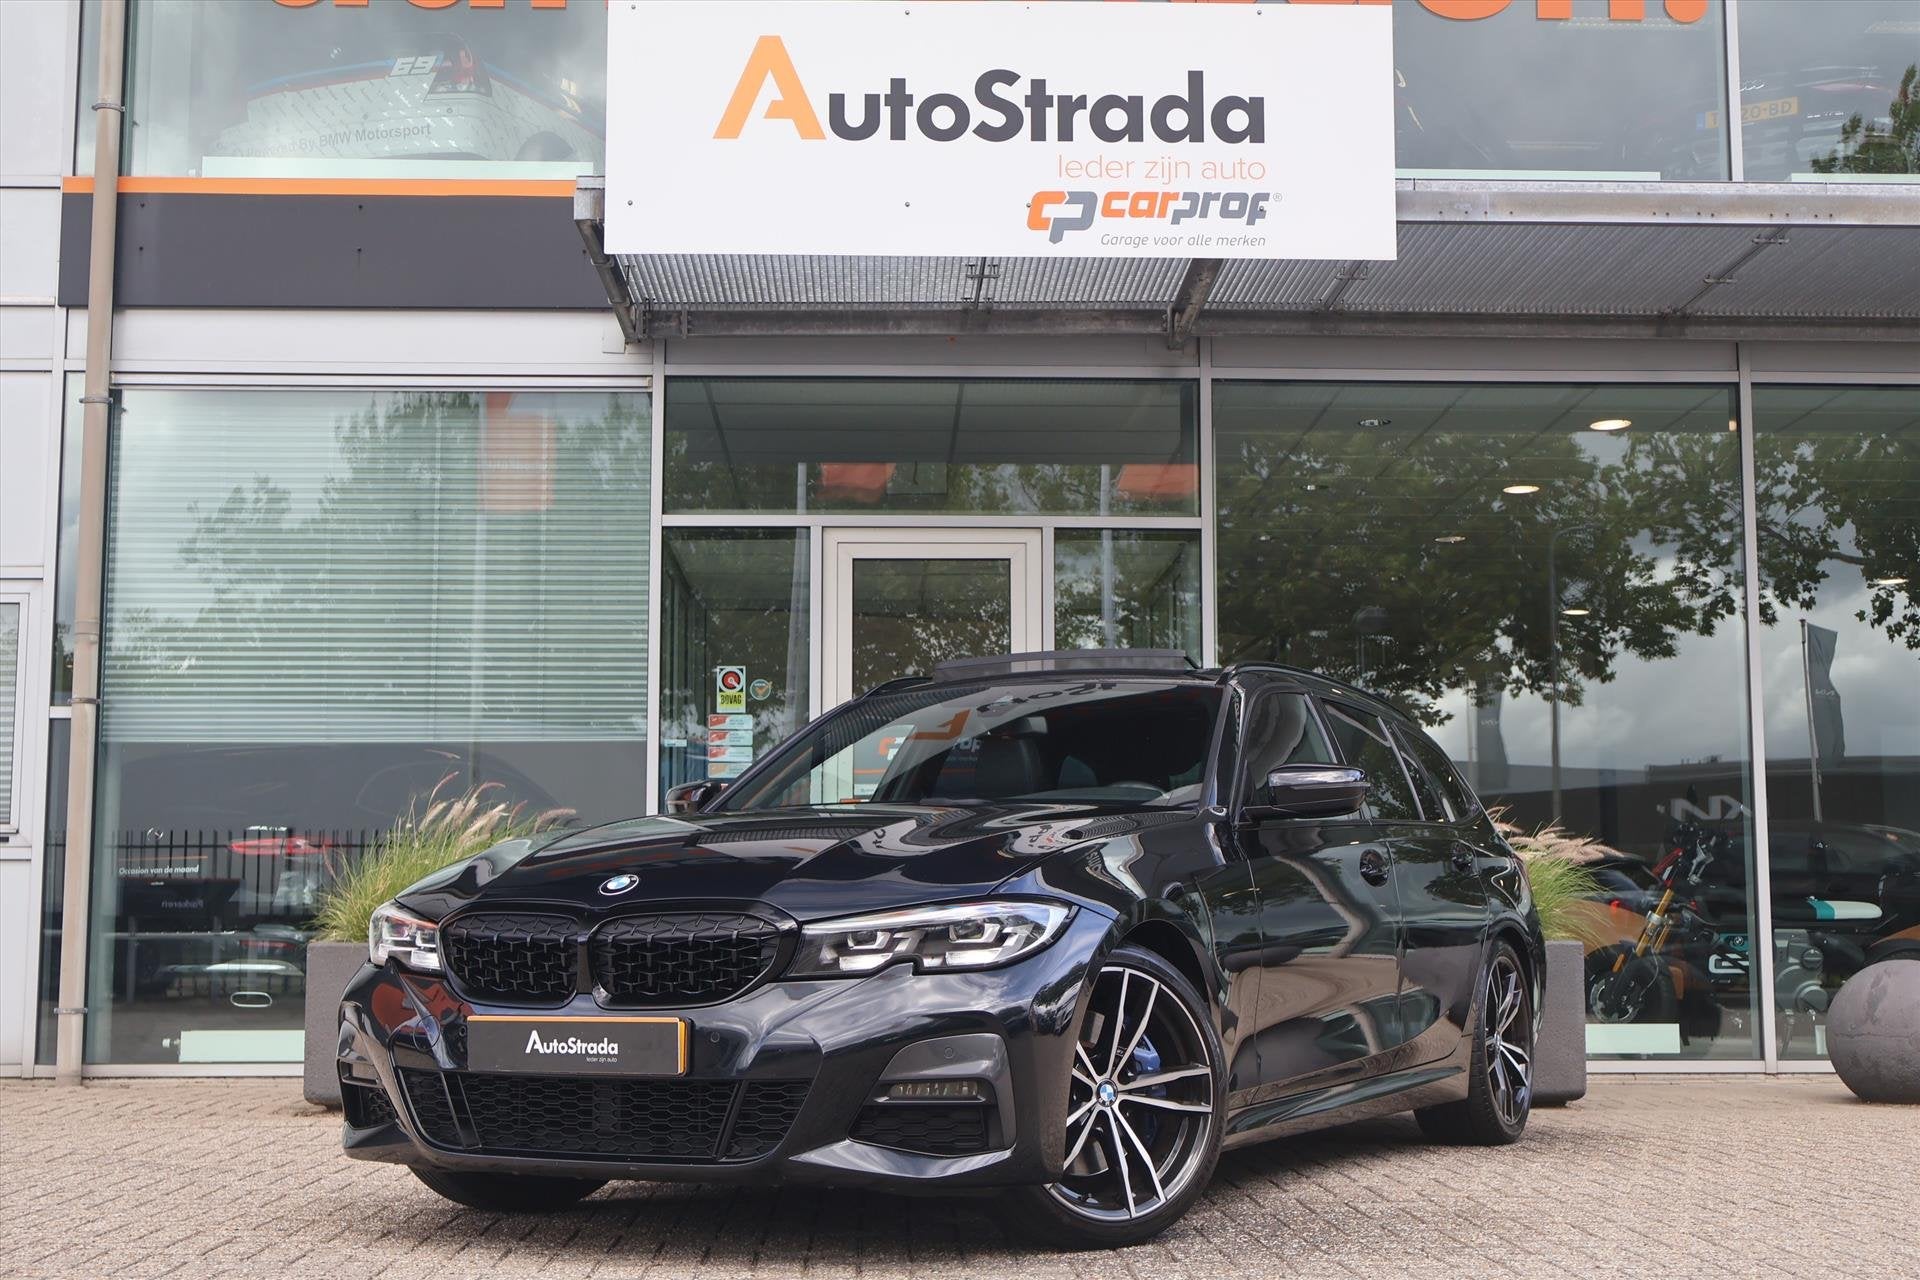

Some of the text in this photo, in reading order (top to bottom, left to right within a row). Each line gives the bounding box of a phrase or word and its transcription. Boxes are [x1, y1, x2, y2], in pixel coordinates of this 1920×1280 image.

[712, 35, 1266, 145] AutoStrada
[320, 131, 352, 148] BMW
[354, 123, 432, 142] Motorsport
[1057, 154, 1267, 185] Ieder zijn auto
[1100, 233, 1267, 249] Garage voor alle merken
[119, 864, 200, 876] Occasion van de maand
[525, 1029, 619, 1055] AutoStrada
